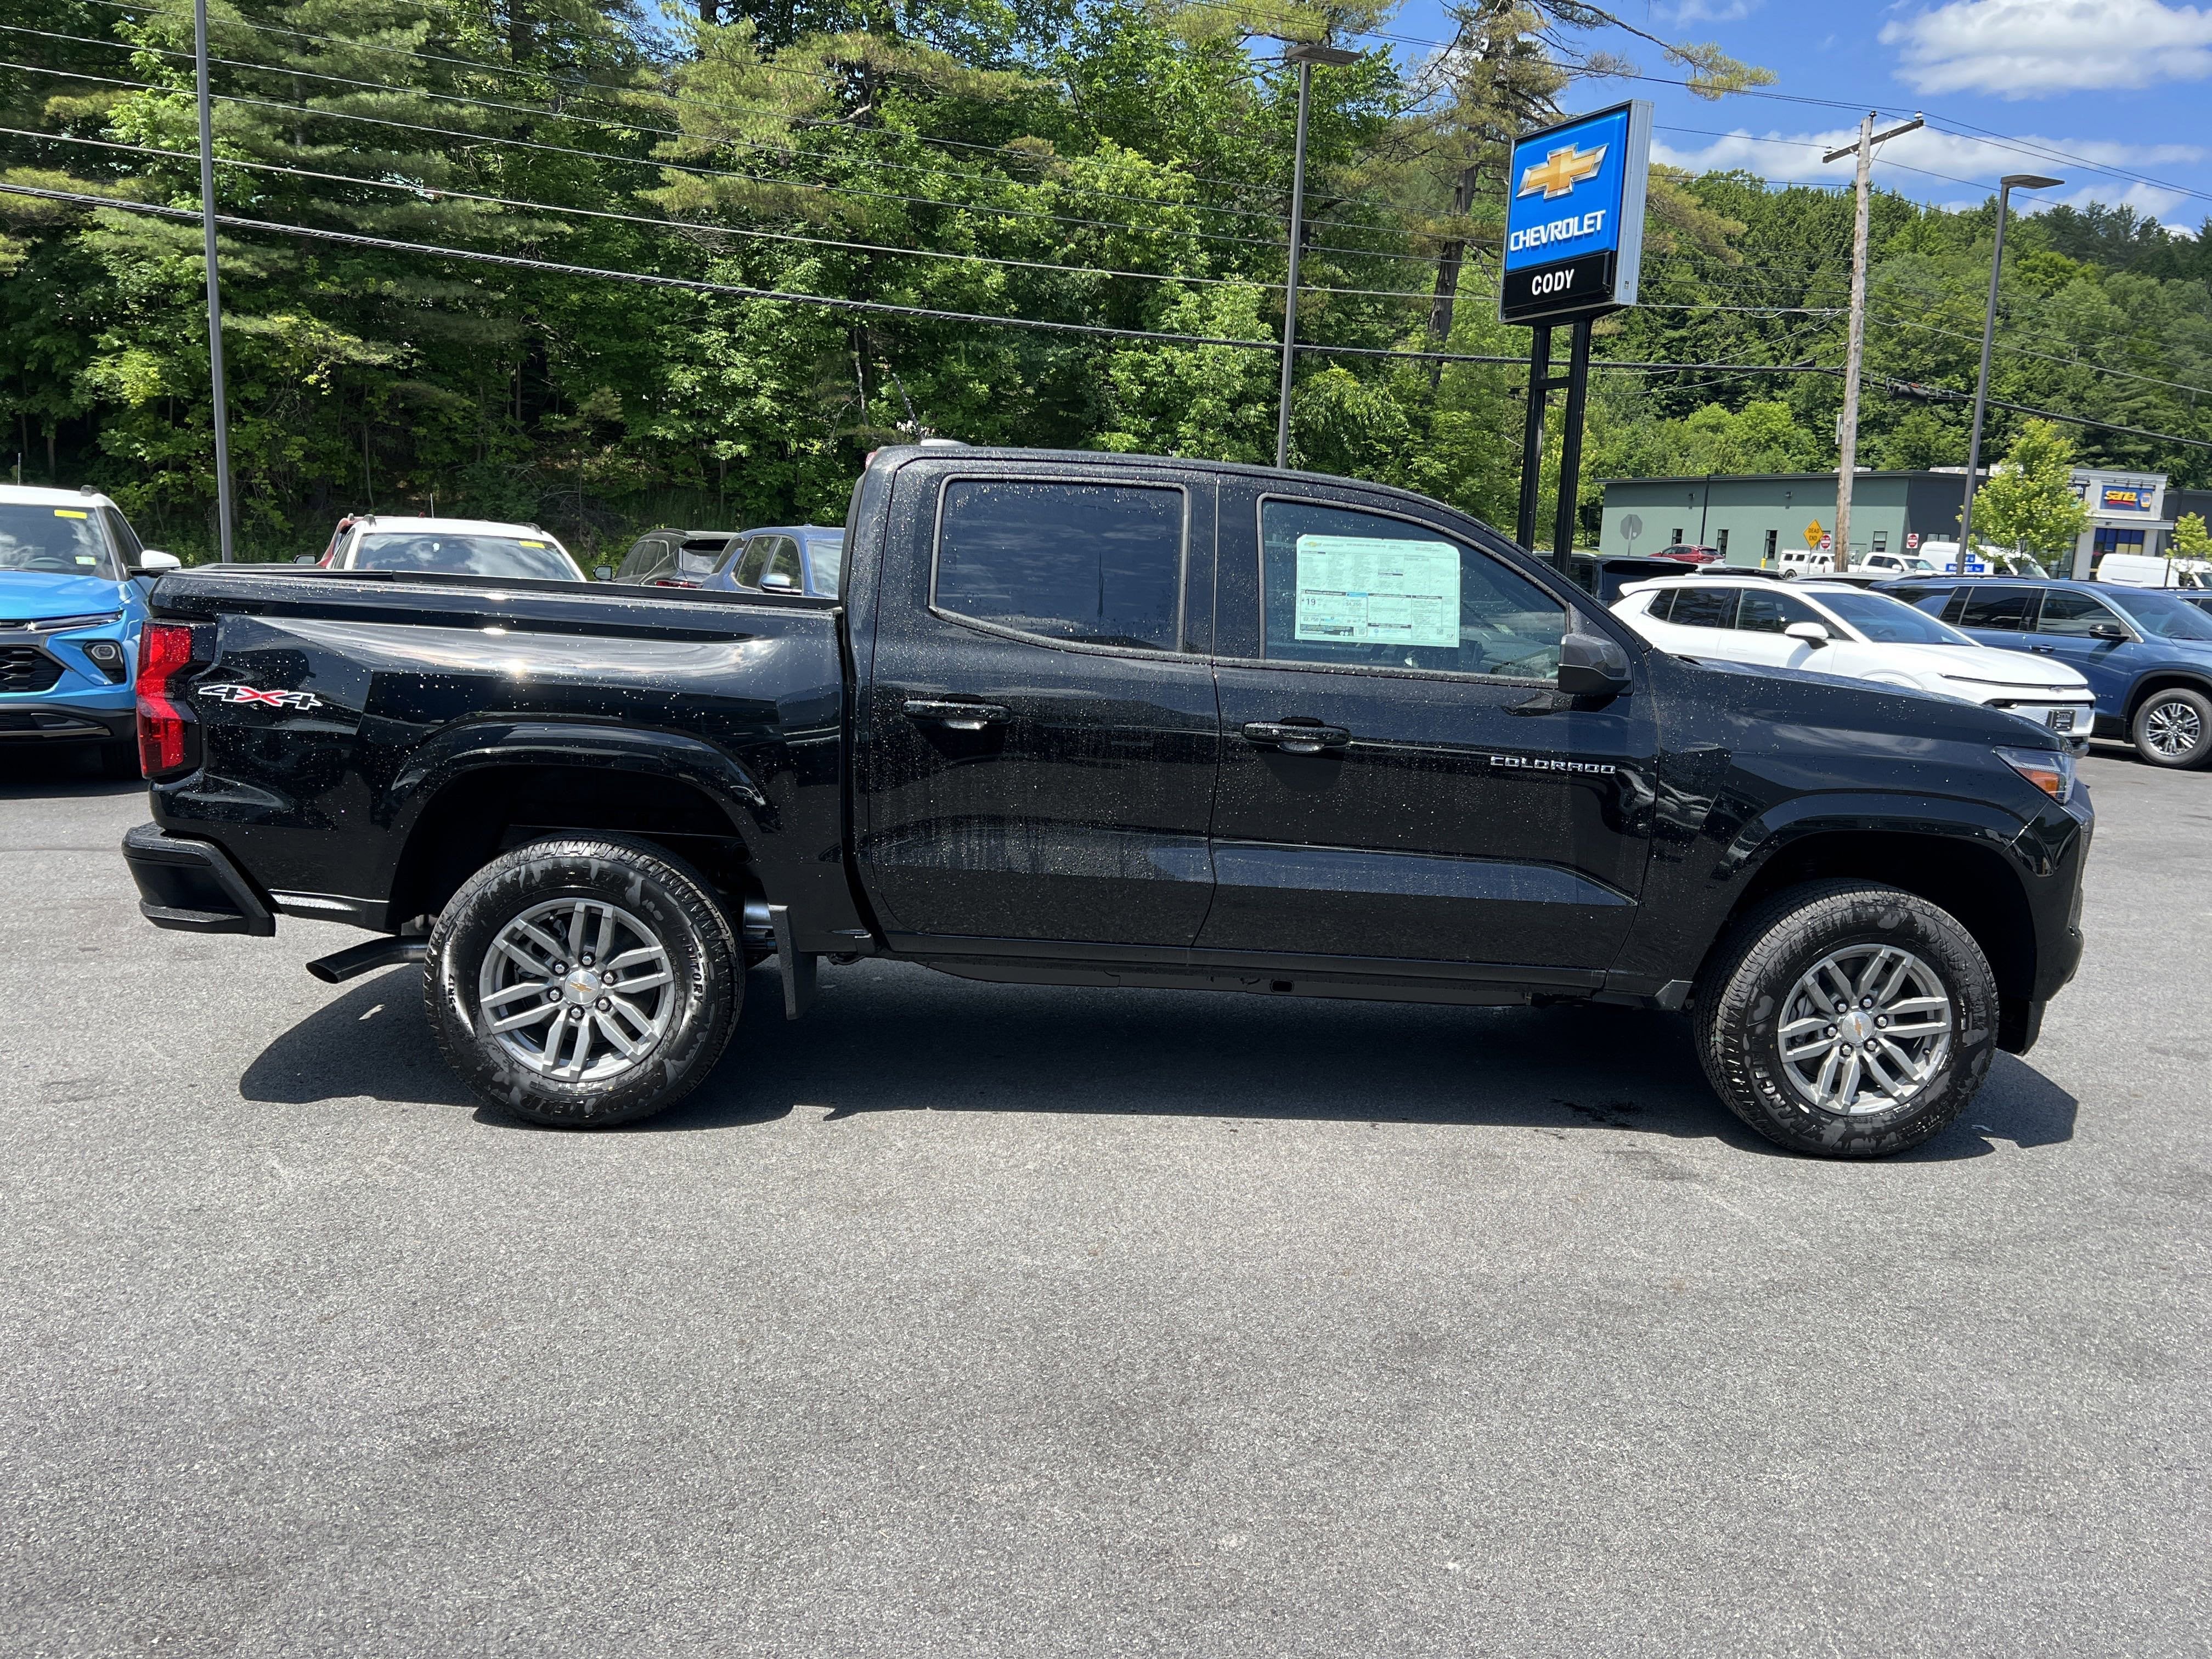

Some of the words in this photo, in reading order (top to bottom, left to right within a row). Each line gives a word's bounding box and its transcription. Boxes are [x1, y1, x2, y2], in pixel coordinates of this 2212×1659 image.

[1510, 209, 1606, 252] CHEVROLET
[1531, 268, 1575, 296] CODY
[1490, 756, 1616, 775] COLORADO
[520, 1069, 669, 1119] GOODYEAR
